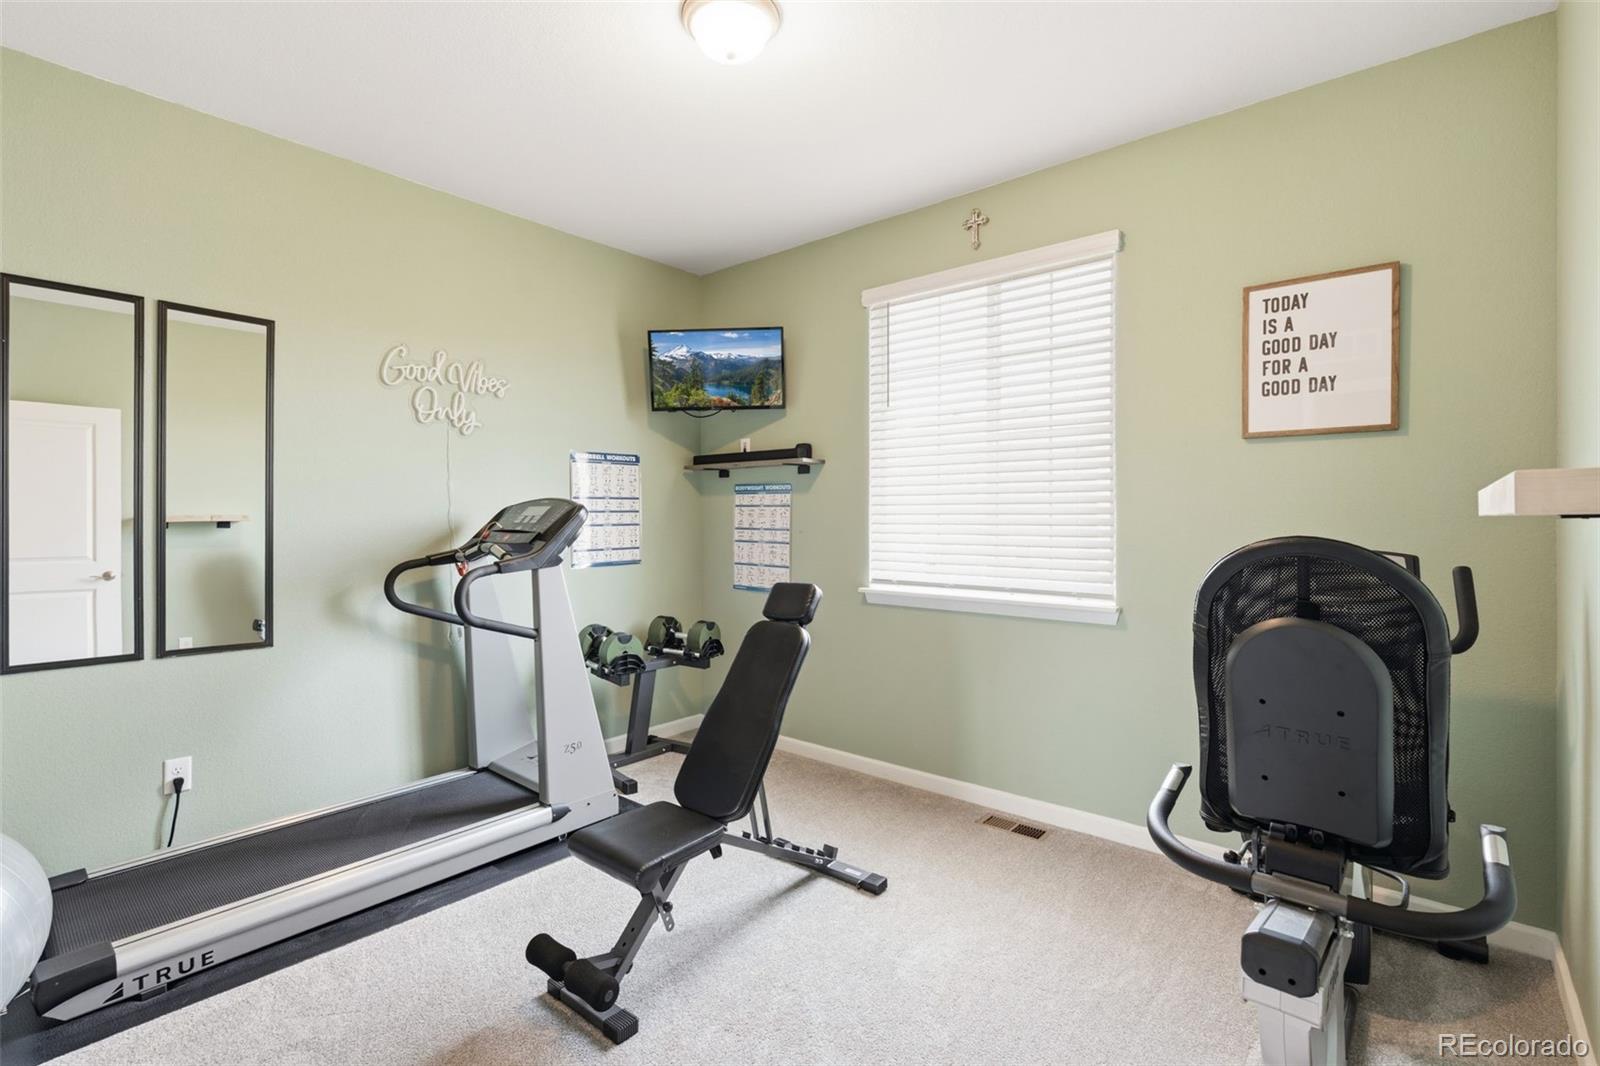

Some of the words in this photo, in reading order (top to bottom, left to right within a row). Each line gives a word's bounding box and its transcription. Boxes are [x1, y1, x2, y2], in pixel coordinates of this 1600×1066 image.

[1262, 292, 1309, 314] TODAY
[1263, 318, 1277, 335] IS
[1284, 316, 1294, 333] A
[1262, 336, 1301, 356] GOOD
[1309, 331, 1338, 351] DAY
[380, 345, 446, 385] Good
[446, 359, 511, 398] Vibes
[1262, 358, 1292, 376] FOR
[1298, 356, 1308, 373] A
[1262, 378, 1301, 397] GOOD
[1308, 375, 1337, 393] DAY
[412, 385, 482, 435] Only
[606, 454, 636, 462] WORKOUTS
[1275, 725, 1351, 751] TRUE
[132, 950, 215, 990] TRUE
